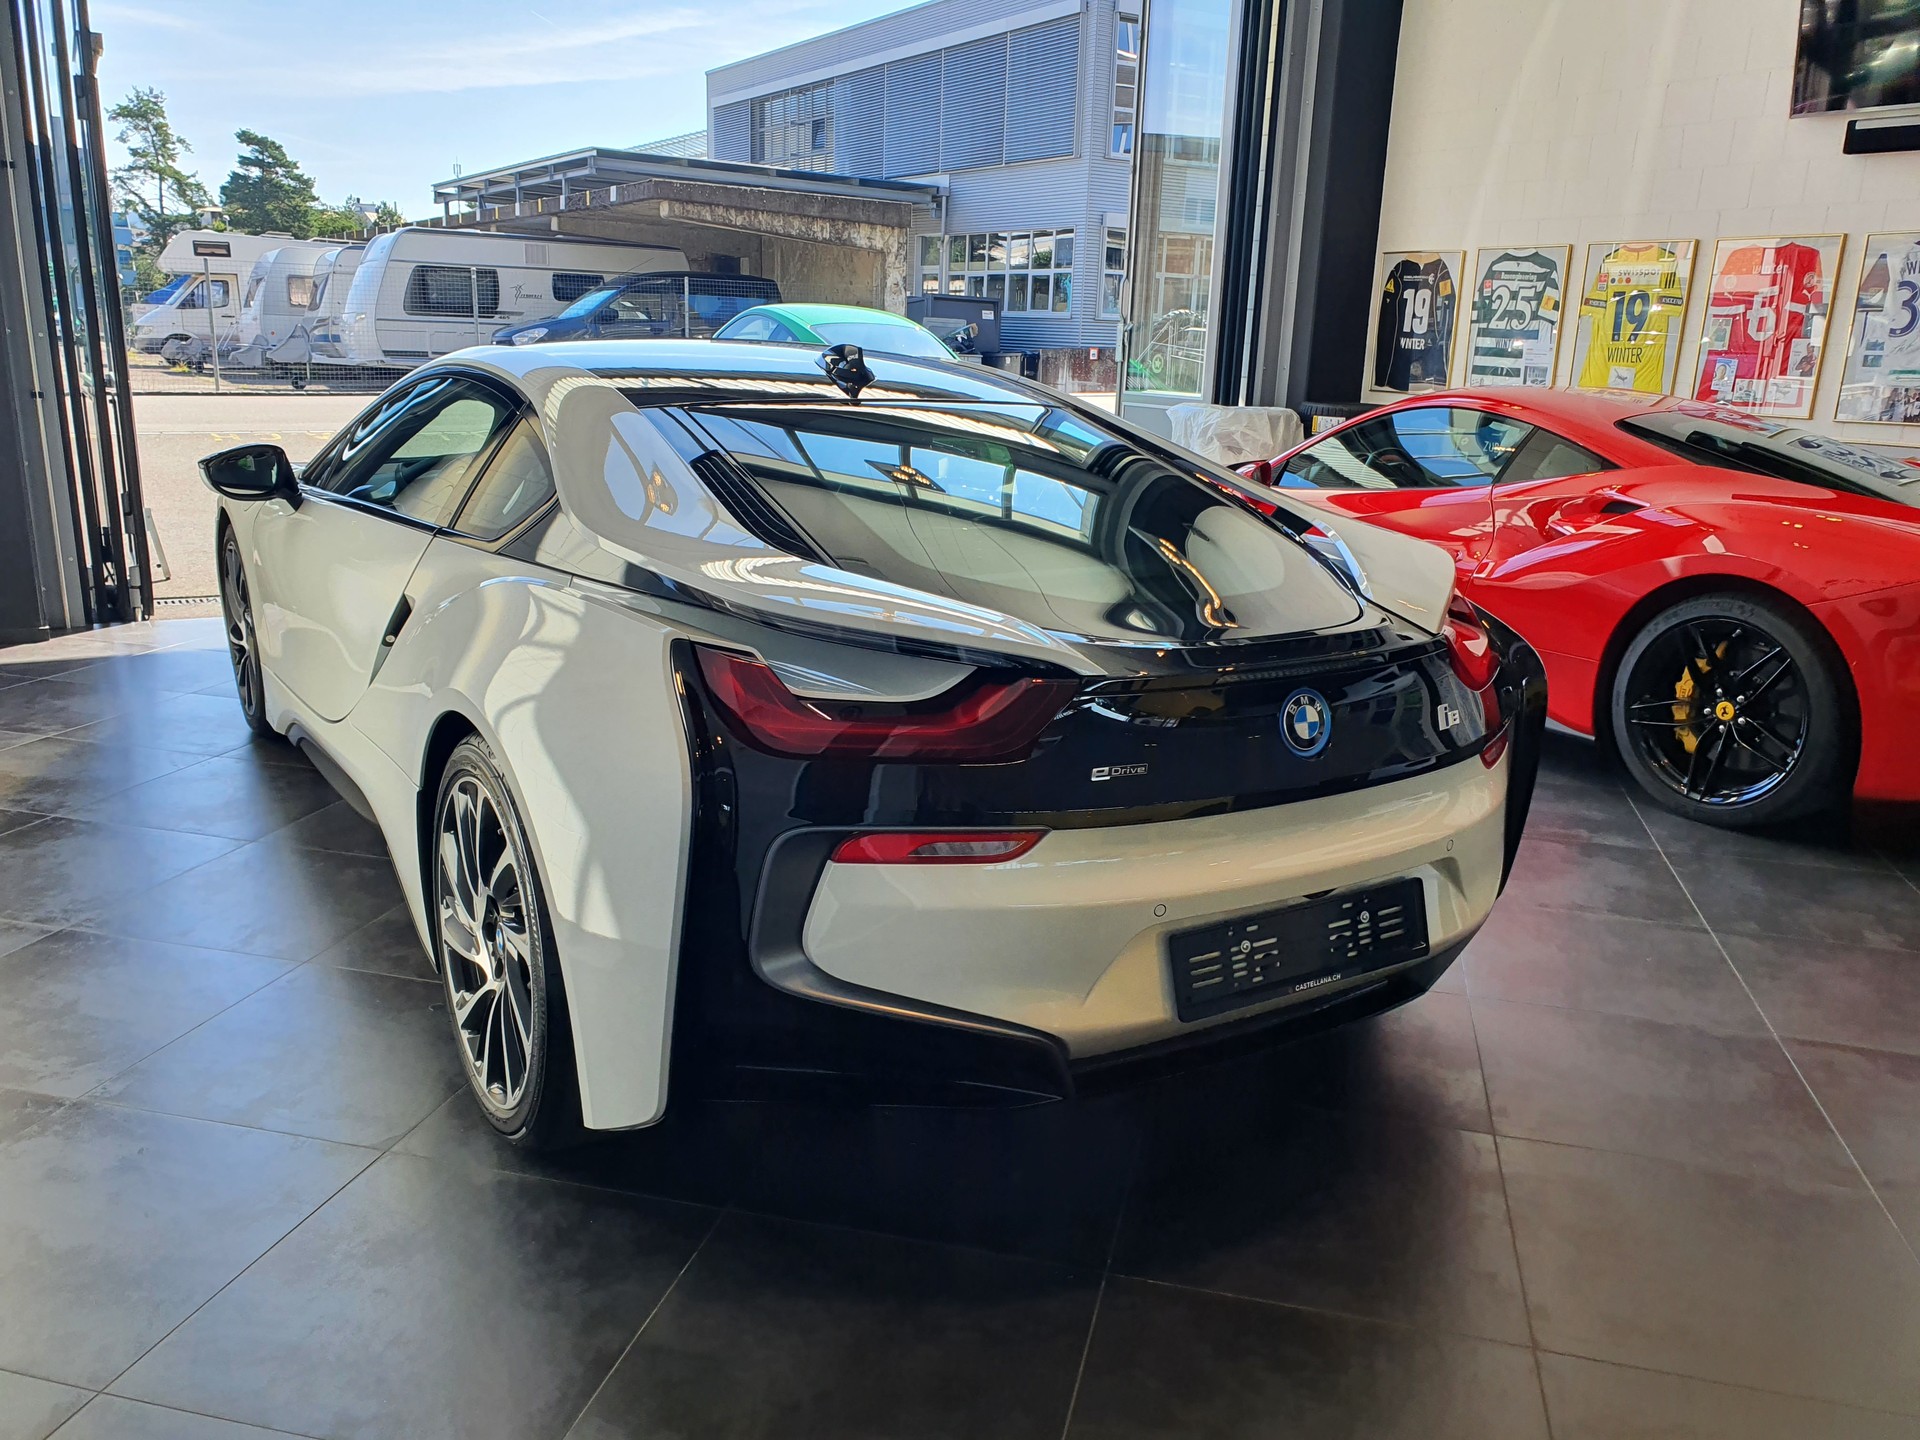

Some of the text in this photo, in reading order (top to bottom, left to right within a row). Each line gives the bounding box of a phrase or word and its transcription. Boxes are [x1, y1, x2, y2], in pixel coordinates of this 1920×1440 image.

[1617, 268, 1660, 278] swisspor
[1403, 288, 1432, 334] 19
[1490, 284, 1536, 330] 25
[1611, 289, 1650, 342] 19
[1746, 285, 1779, 341] 6
[1400, 337, 1425, 350] WINTER
[1607, 347, 1643, 363] WINTER
[1288, 695, 1322, 715] BMW
[1295, 973, 1342, 992] CASTELLANA.CH
